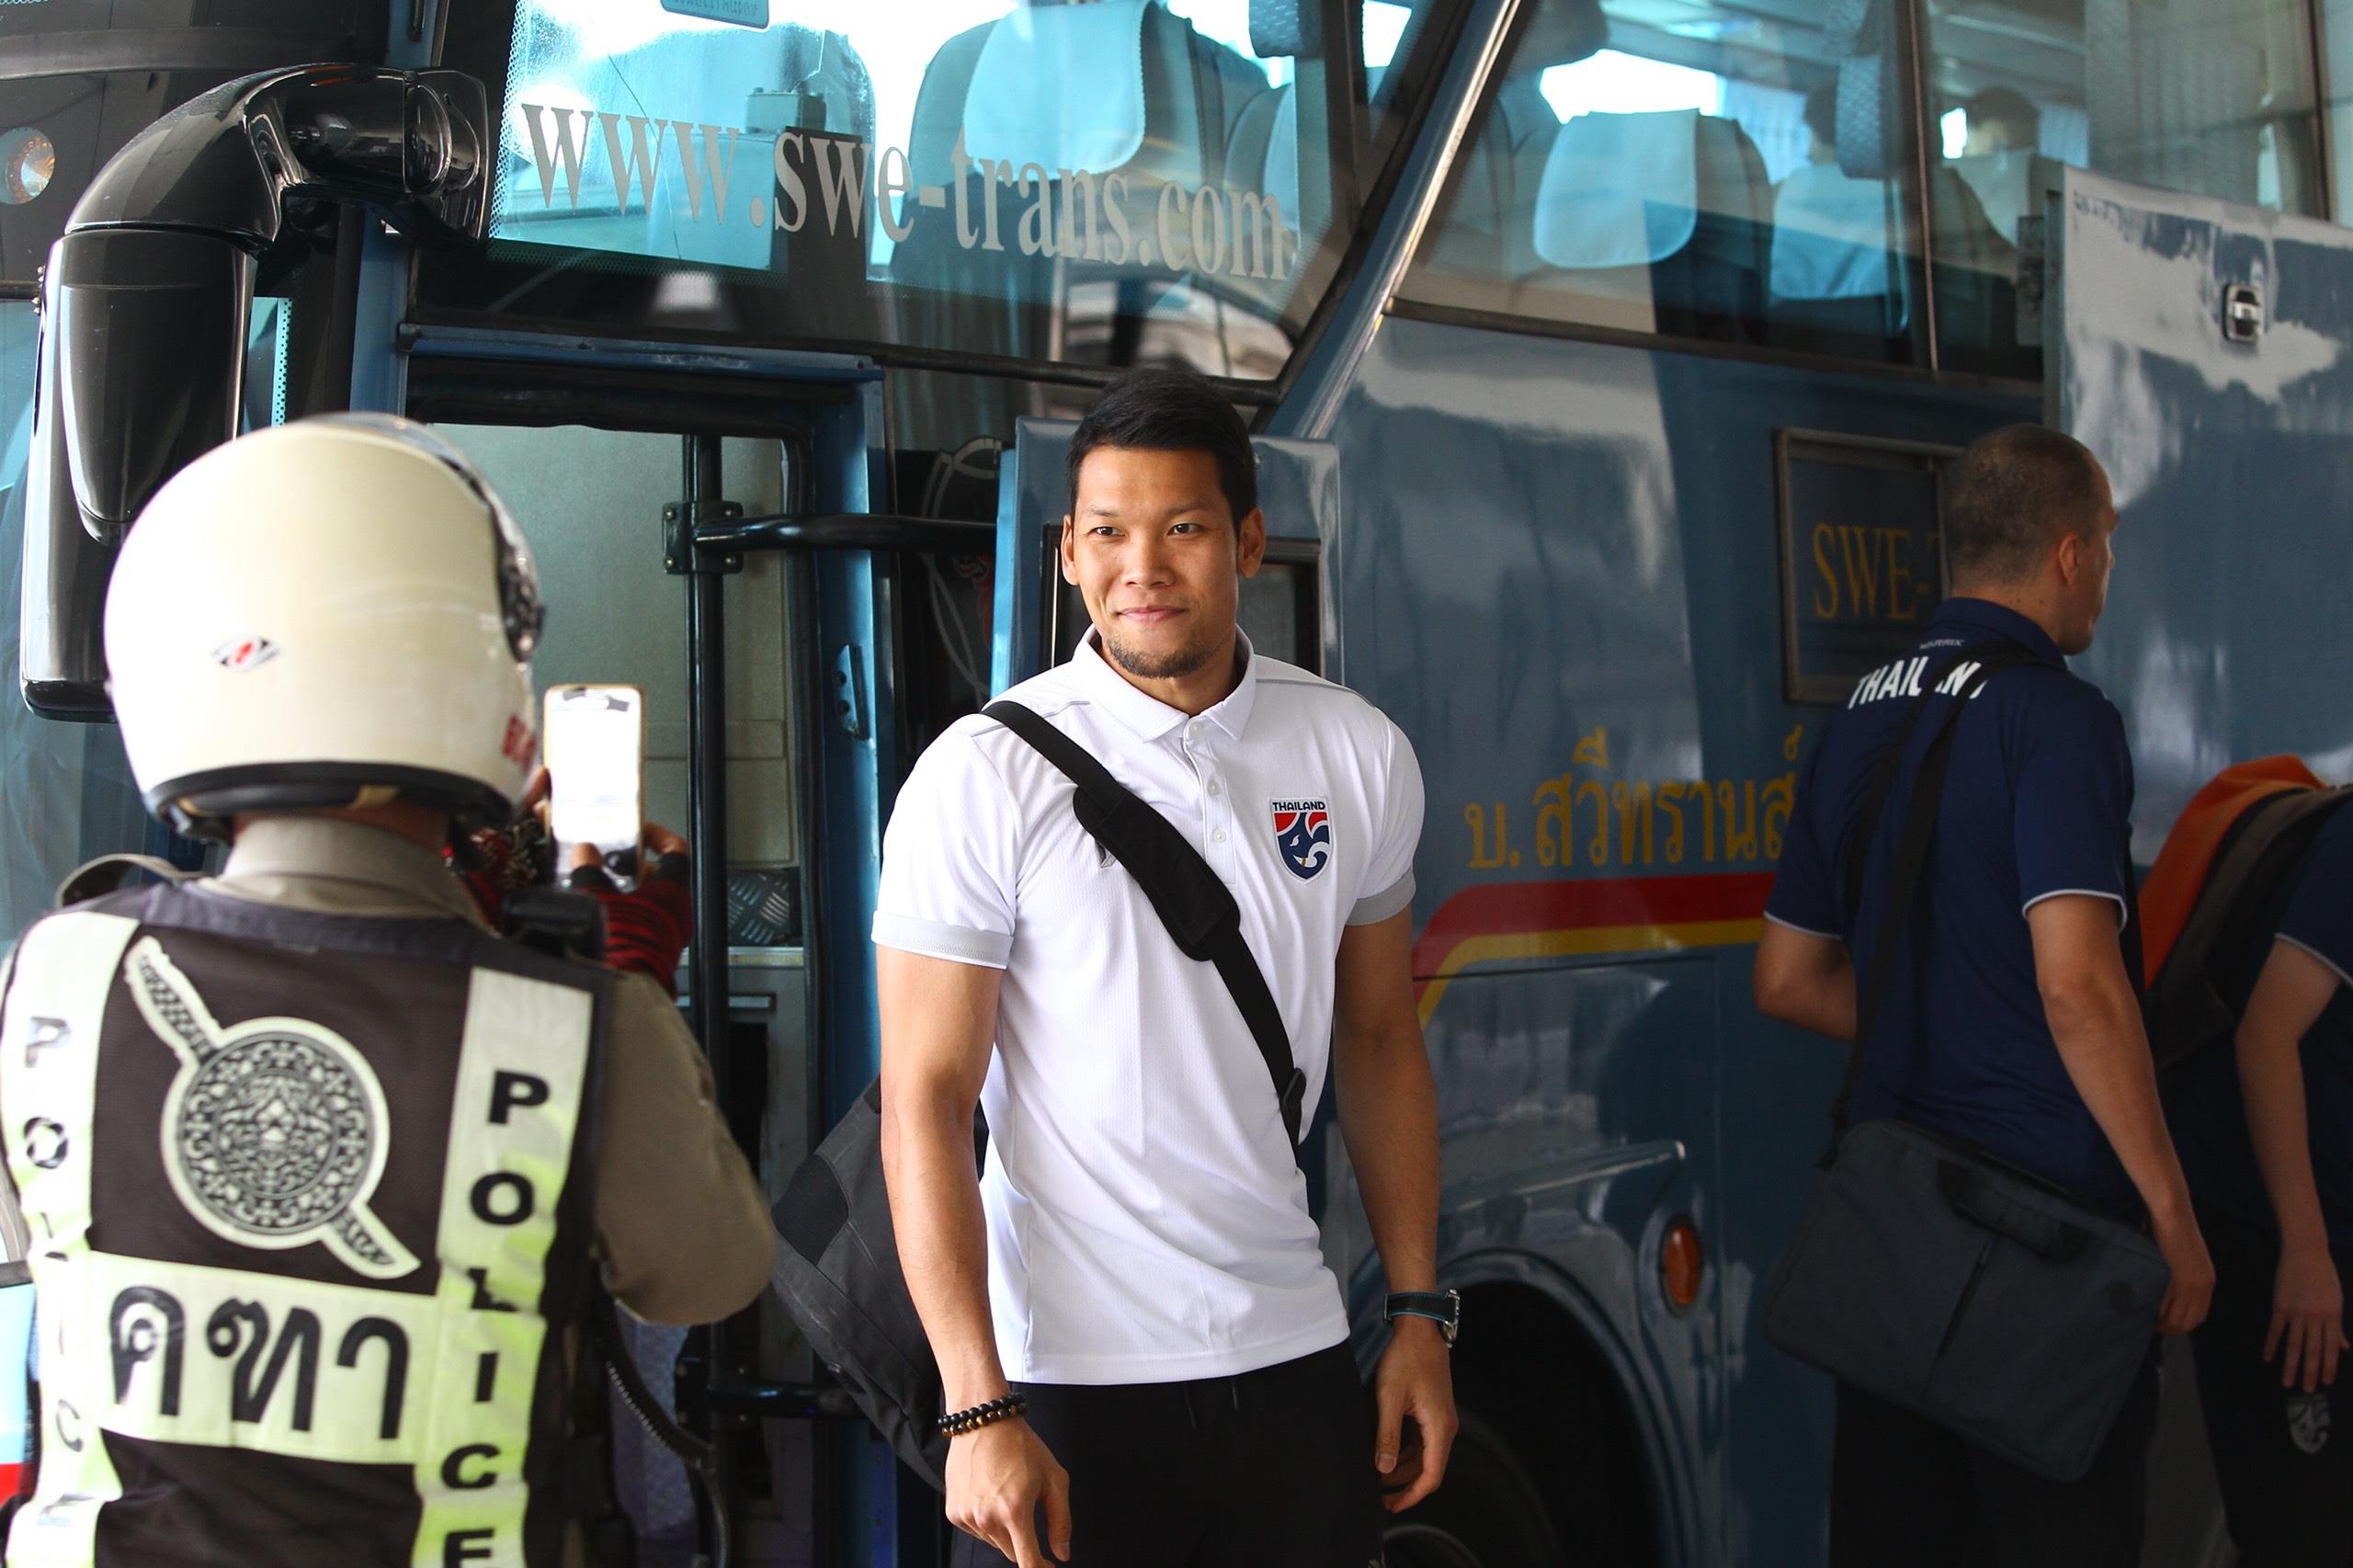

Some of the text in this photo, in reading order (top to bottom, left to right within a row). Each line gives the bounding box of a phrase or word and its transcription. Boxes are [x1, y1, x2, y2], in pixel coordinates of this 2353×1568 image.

[521, 103, 1288, 280] www.swe-trans.com
[1812, 522, 1939, 620] SWE-
[1847, 655, 1988, 710] THAILN
[1272, 801, 1325, 812] THAILAND
